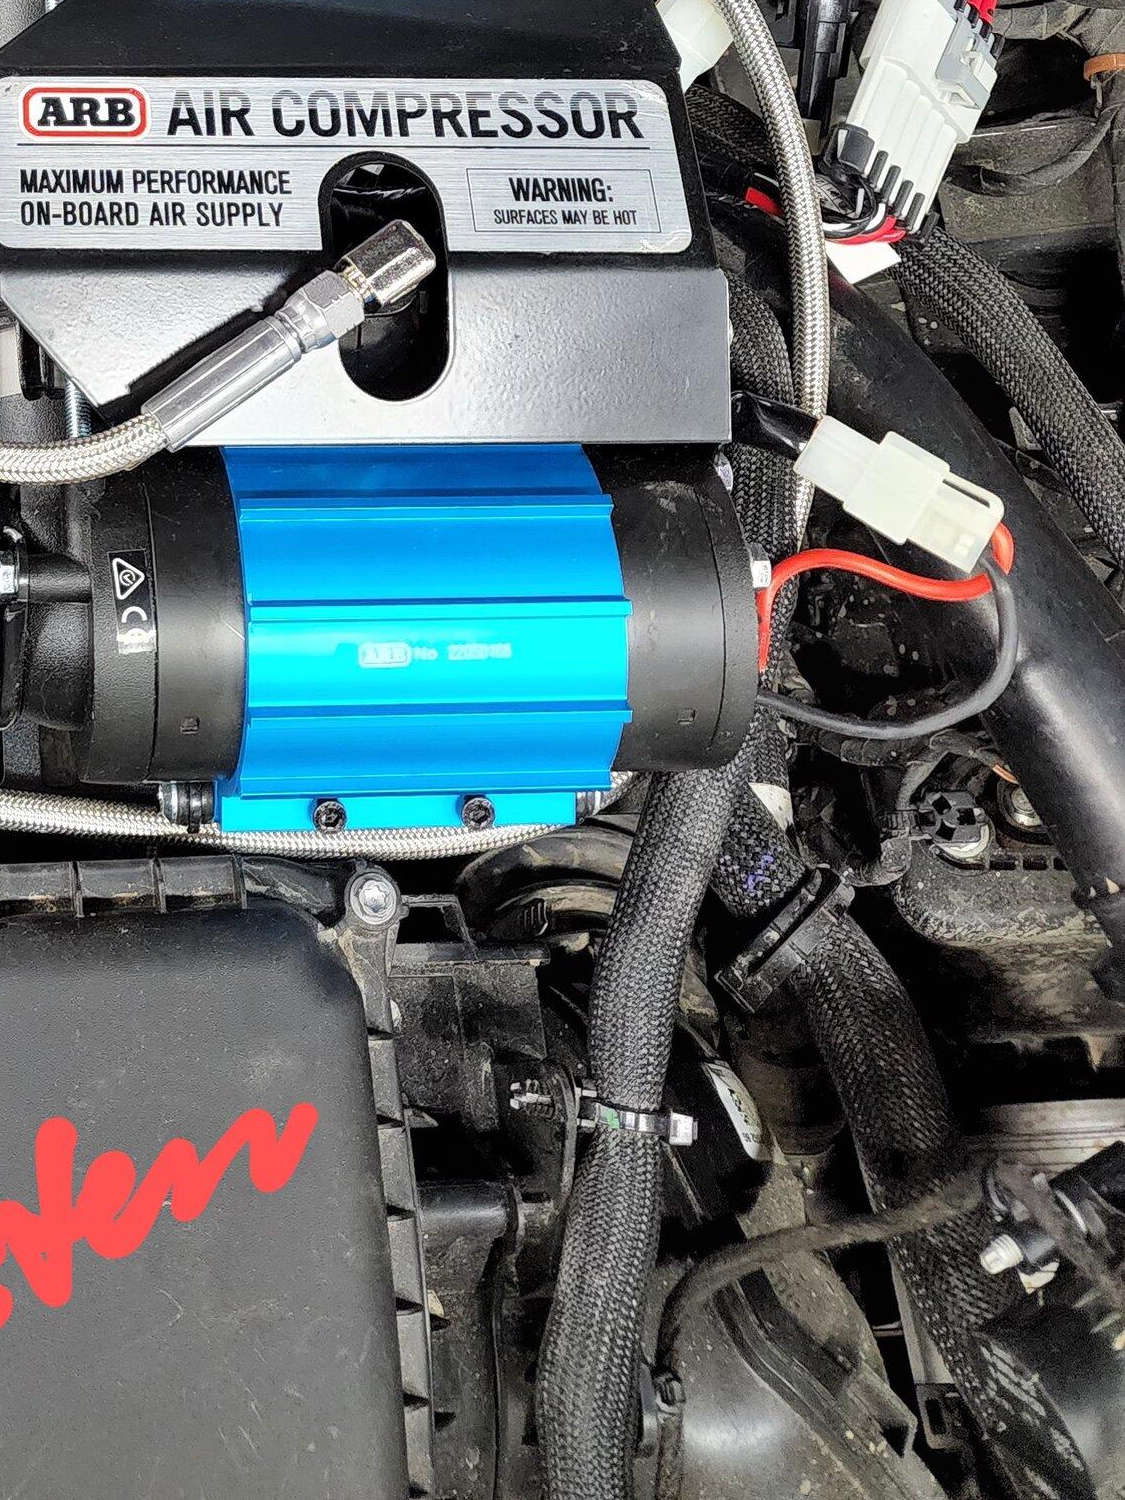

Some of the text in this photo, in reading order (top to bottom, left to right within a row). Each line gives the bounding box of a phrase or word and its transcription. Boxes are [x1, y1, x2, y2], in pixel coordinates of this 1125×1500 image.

[36, 89, 645, 139] ARB AIR COMPRESSOR
[20, 169, 292, 196] MAXIMUM PERFORMANCE
[508, 177, 615, 204] WARNING:
[20, 201, 283, 227] ON-BOARD AIR SUPPLY
[493, 209, 638, 226] SURFACES MAY BE HOT
